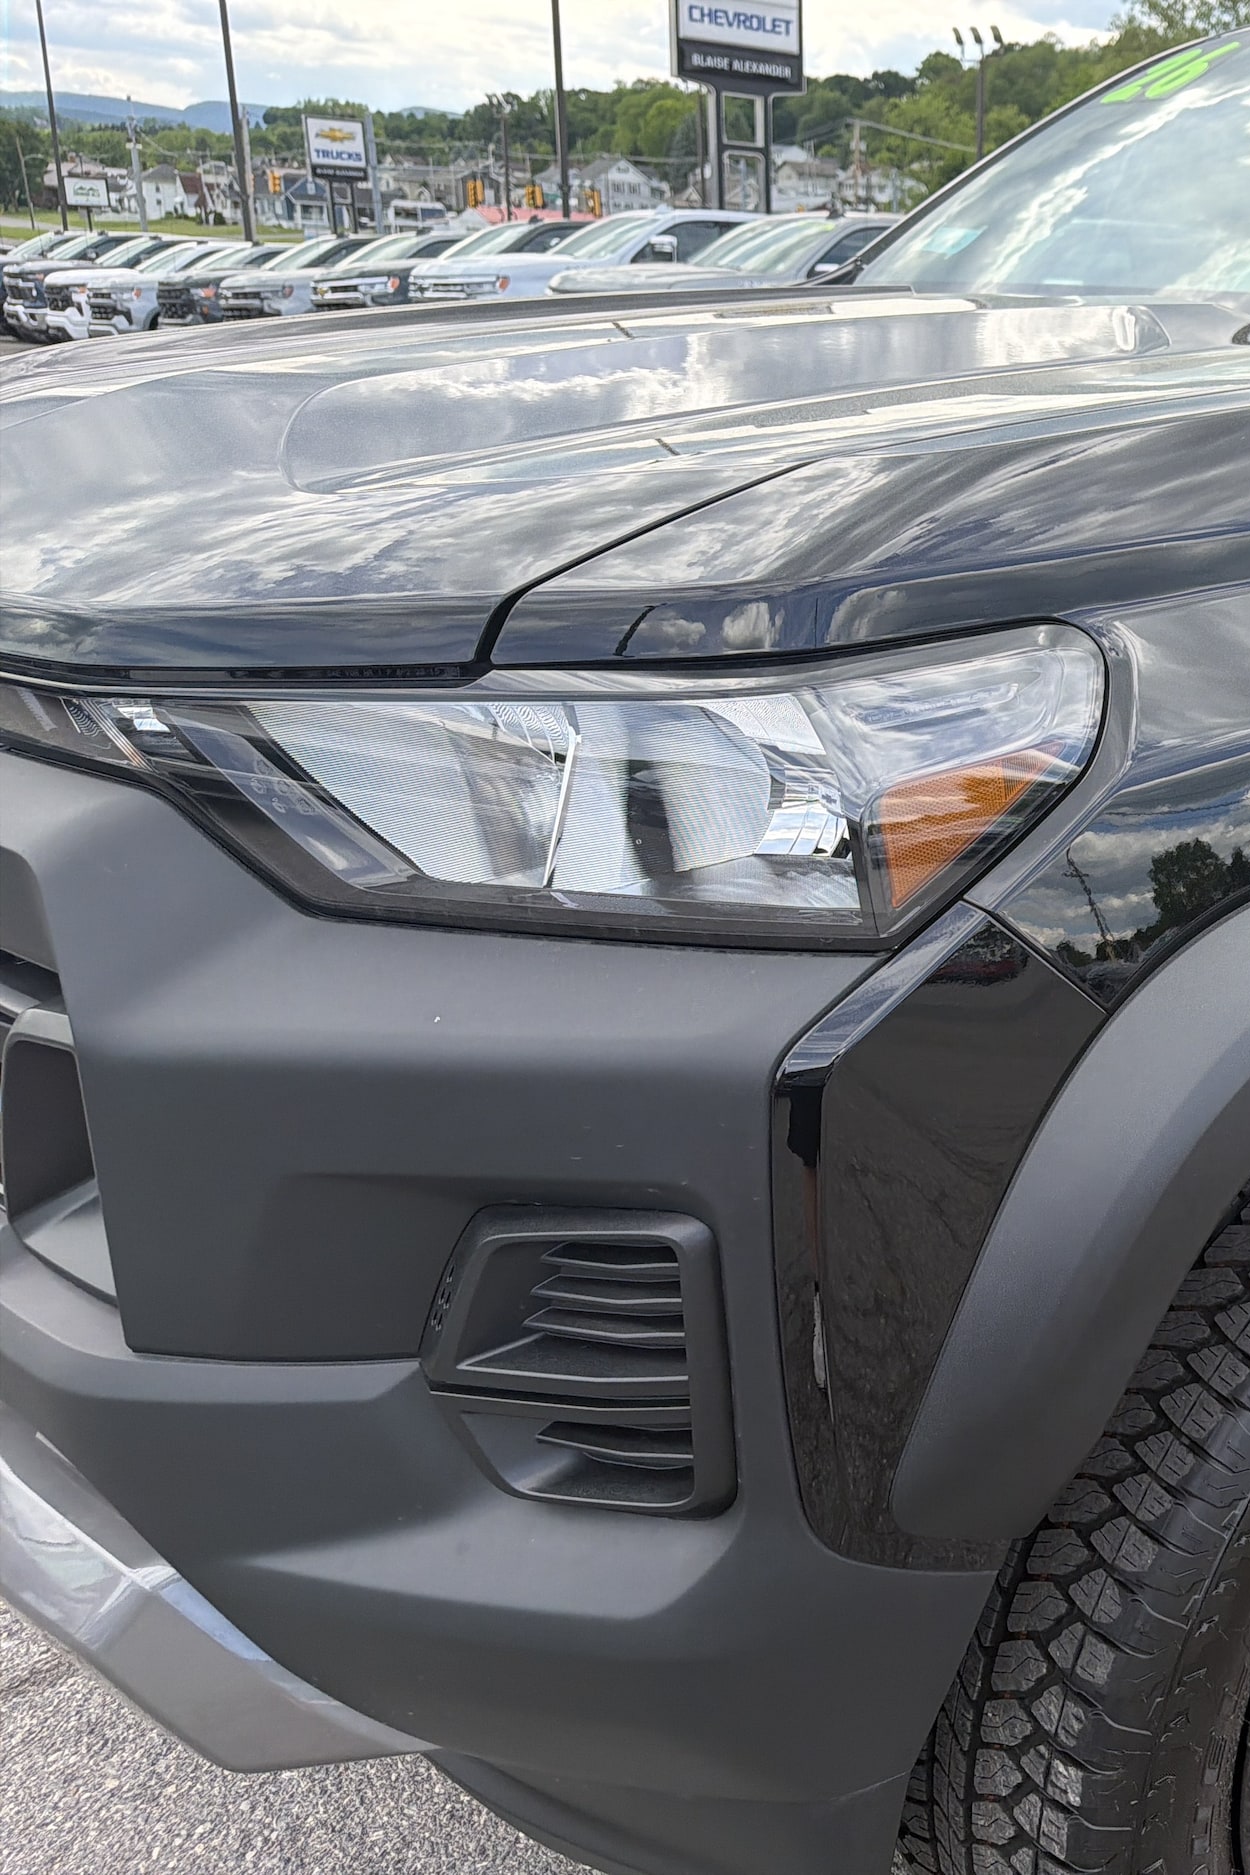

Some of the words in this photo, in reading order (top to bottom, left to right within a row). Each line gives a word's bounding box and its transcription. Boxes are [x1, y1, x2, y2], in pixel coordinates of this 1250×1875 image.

[688, 5, 792, 36] CHEVROLET
[691, 53, 730, 71] BLAISE
[731, 58, 792, 80] ALEXANDER
[314, 148, 362, 162] TRUCKS
